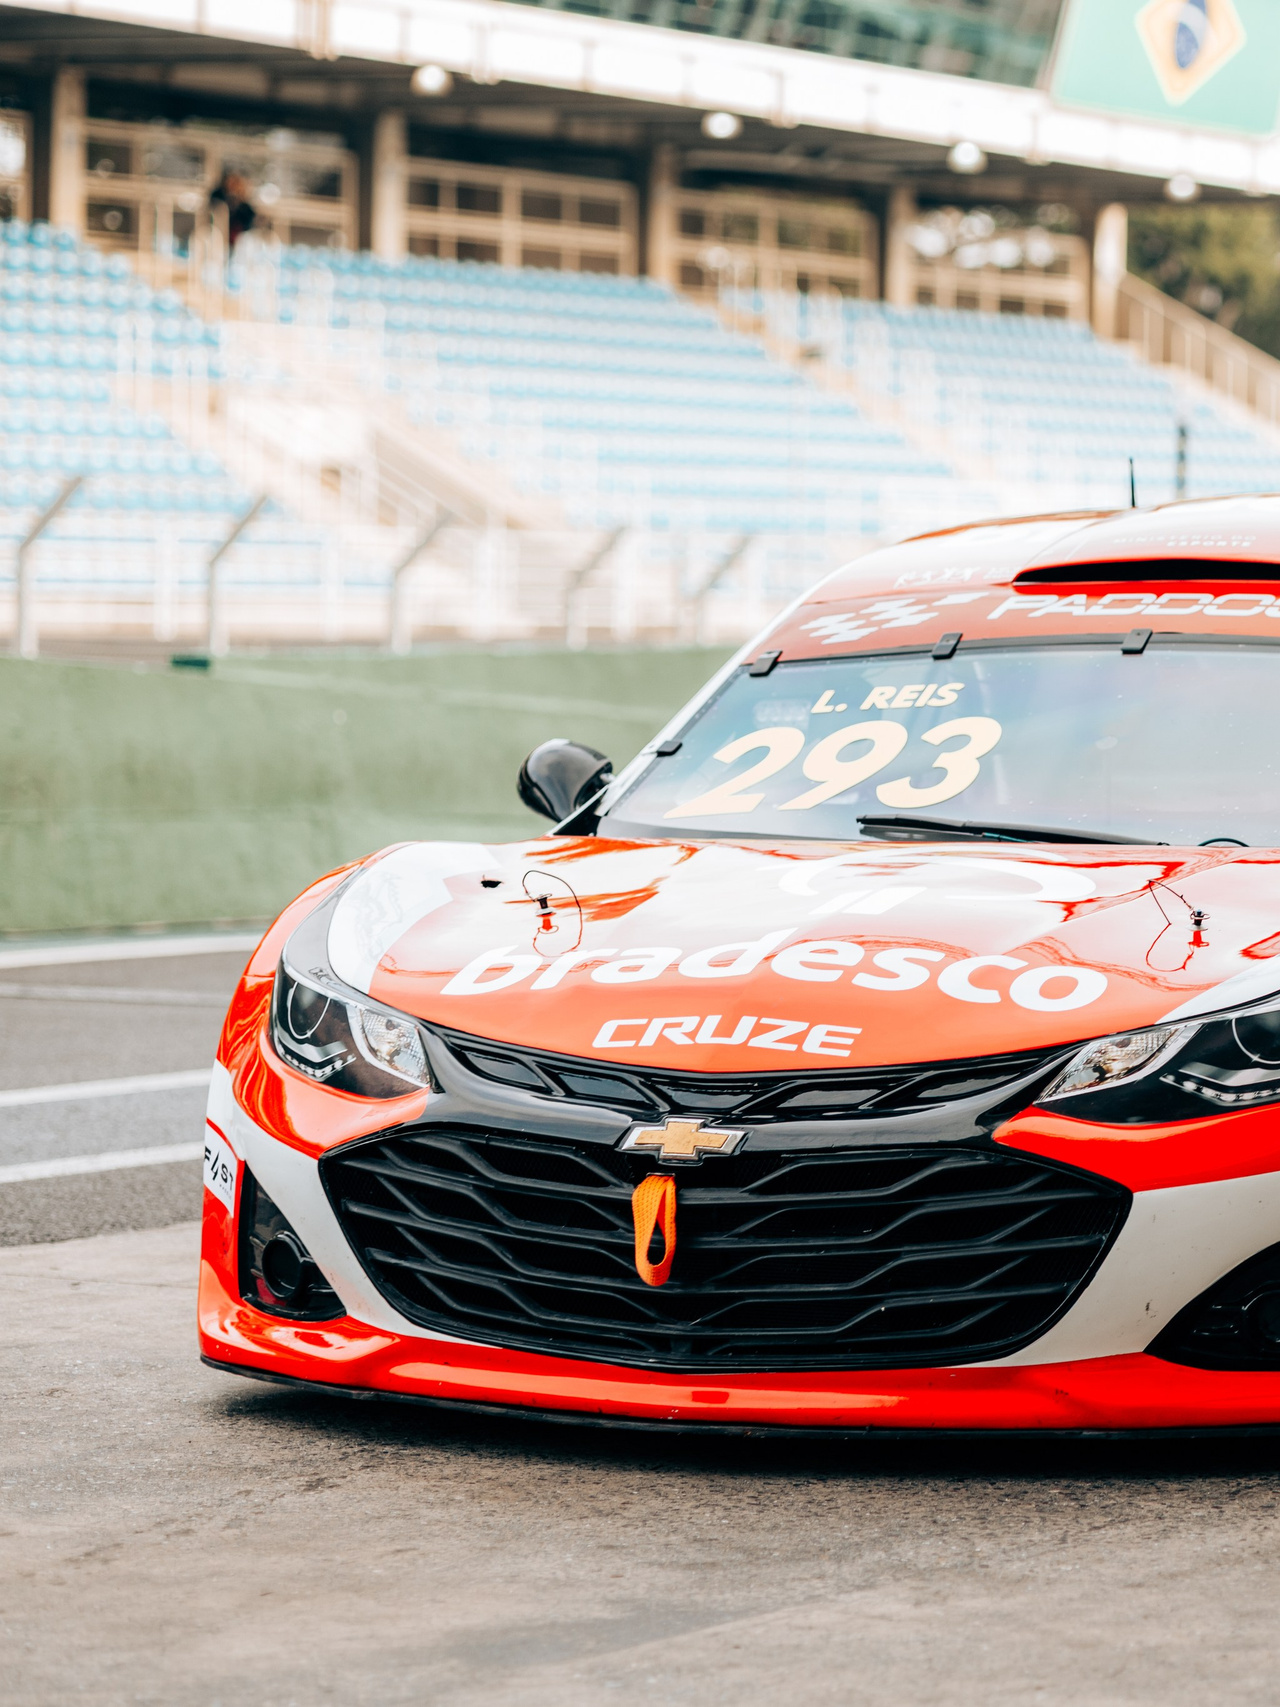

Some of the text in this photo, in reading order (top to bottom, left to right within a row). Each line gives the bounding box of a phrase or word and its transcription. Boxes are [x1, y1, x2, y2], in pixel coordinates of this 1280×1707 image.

[810, 682, 965, 714] L. REIS
[663, 716, 1002, 819] 293
[440, 928, 1108, 1011] bradesco
[592, 1015, 863, 1057] CRUZE
